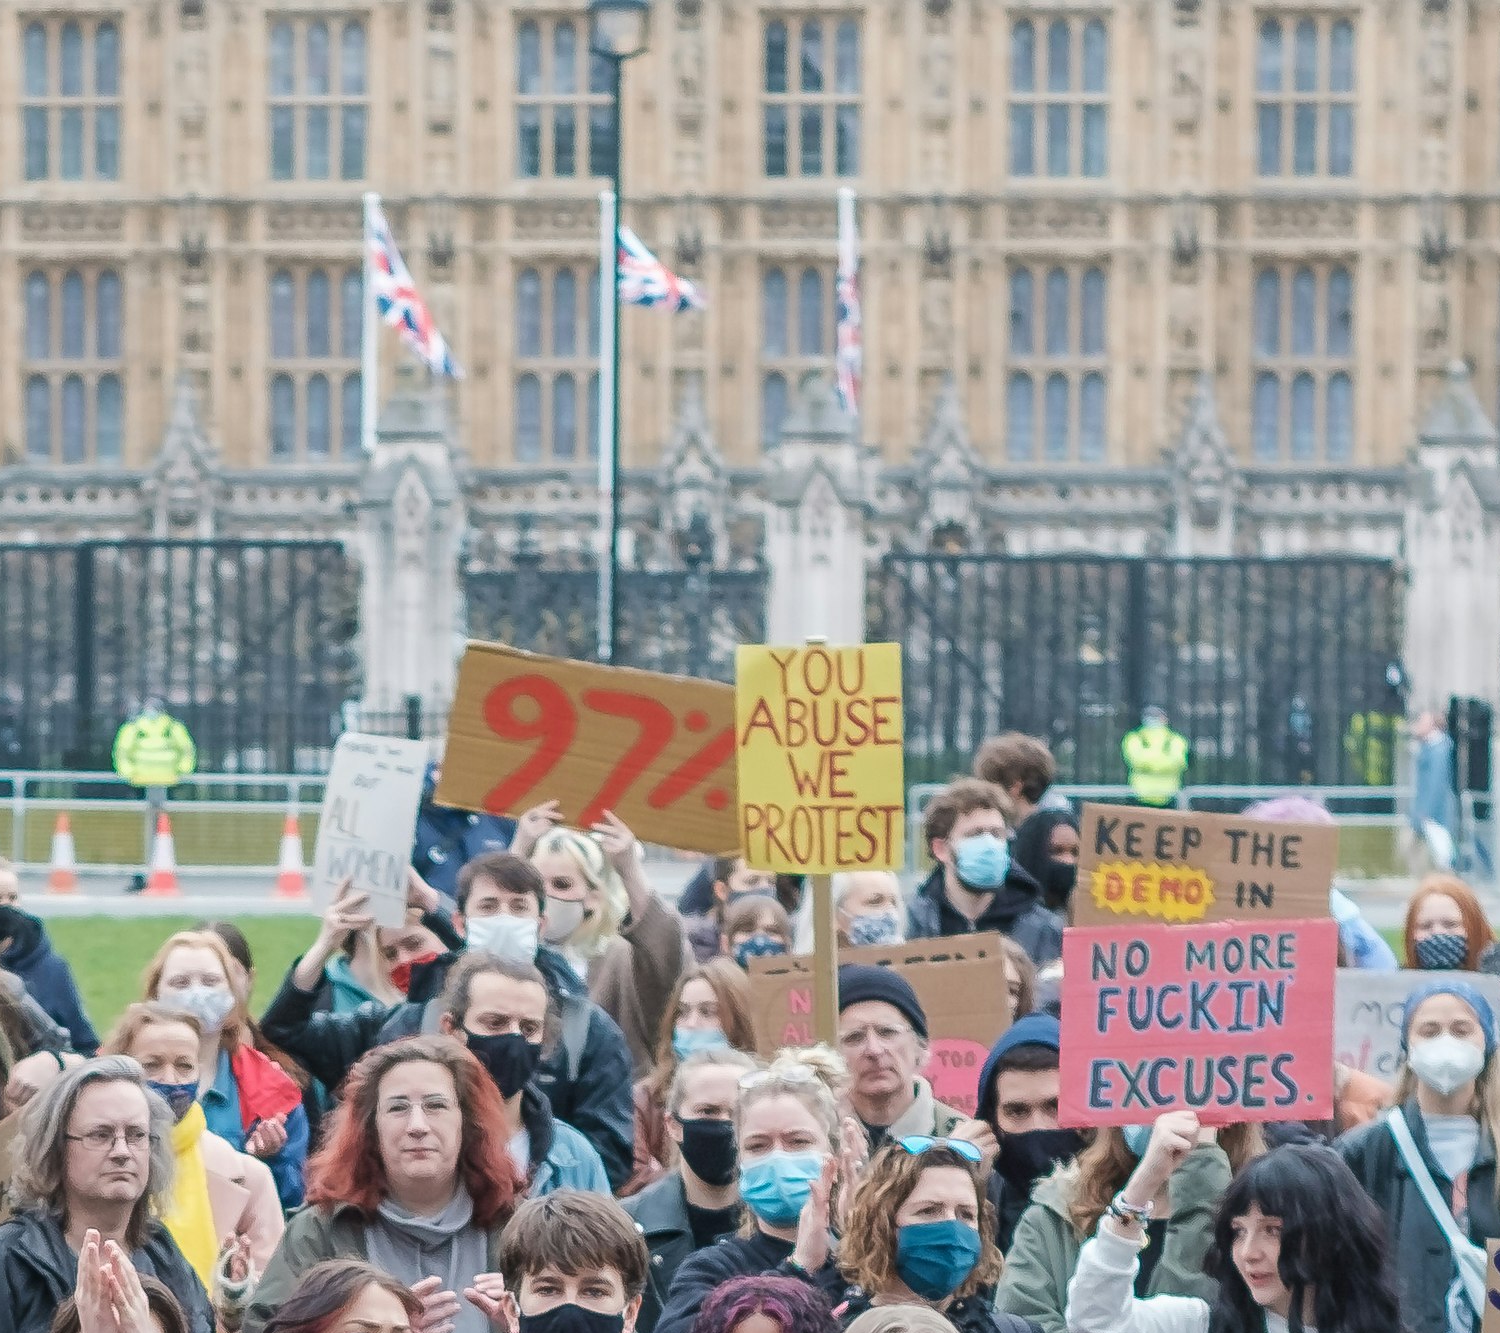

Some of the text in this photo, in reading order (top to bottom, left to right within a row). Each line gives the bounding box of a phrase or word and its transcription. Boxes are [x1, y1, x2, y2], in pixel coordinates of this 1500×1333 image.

[769, 648, 865, 696] YOU
[741, 695, 901, 747] ABUSE
[787, 750, 855, 798] WE
[743, 803, 904, 866] PROTEST
[1094, 816, 1303, 869] KEEP THE
[1103, 871, 1275, 909] DEMO IN
[1090, 933, 1297, 982] NO MORE
